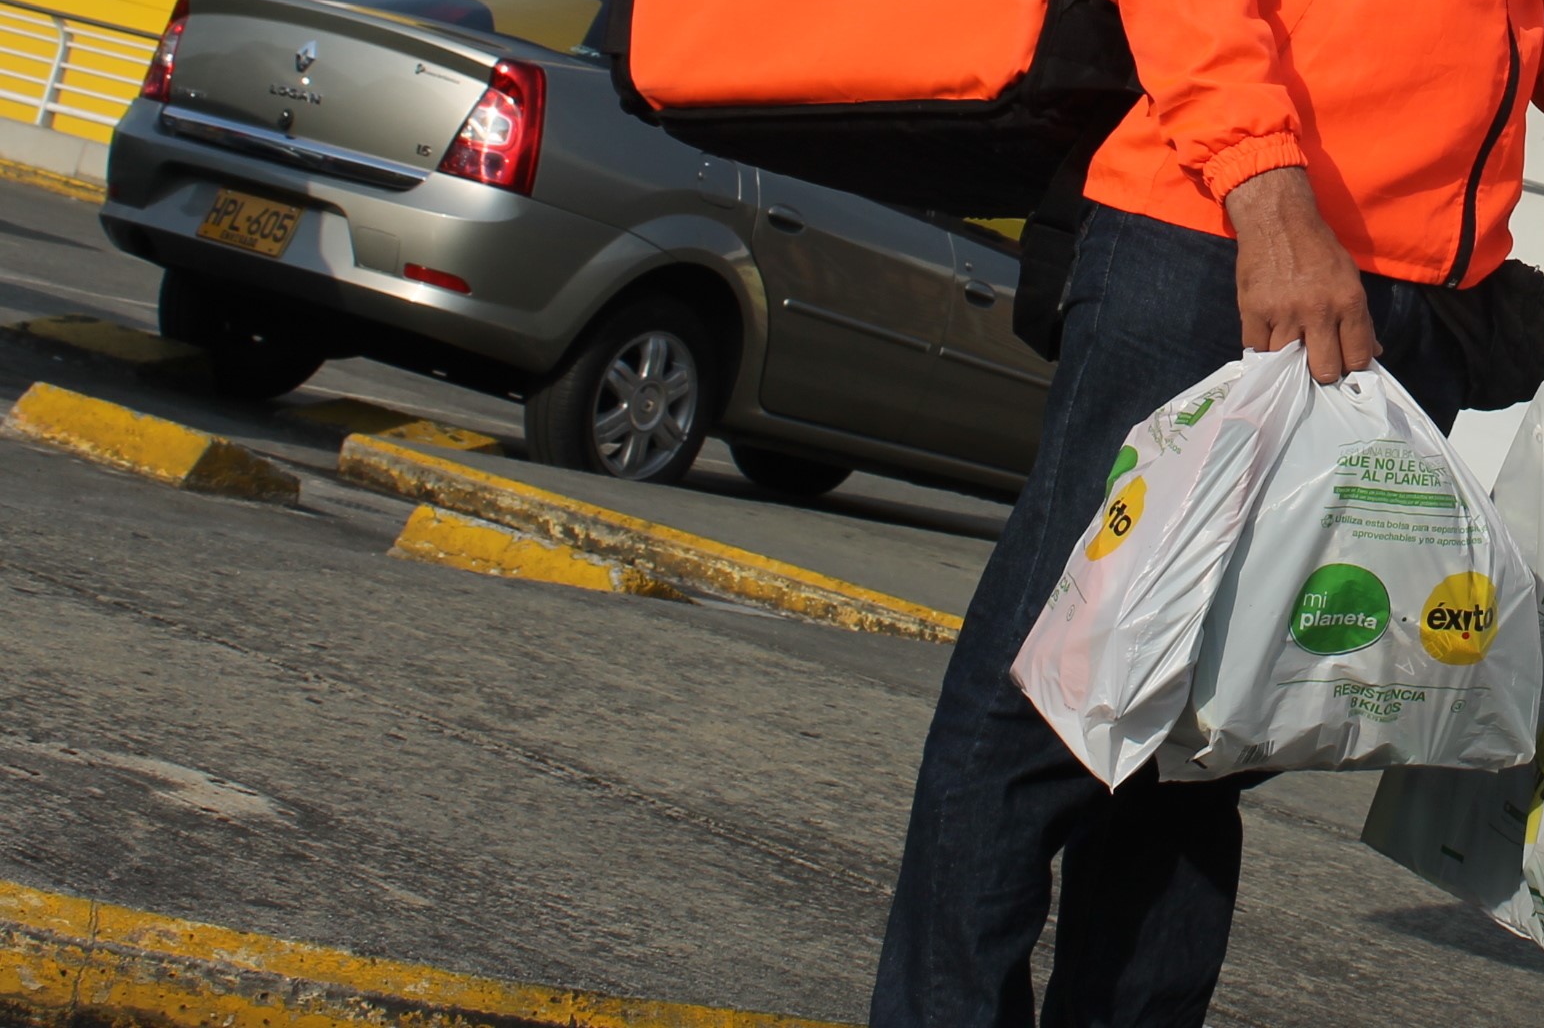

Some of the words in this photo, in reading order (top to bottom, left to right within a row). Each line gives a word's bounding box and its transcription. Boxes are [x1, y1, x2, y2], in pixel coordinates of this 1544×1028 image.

[269, 83, 322, 106] LOGAN
[1374, 457, 1395, 471] NO
[1400, 459, 1415, 472] LE
[1361, 470, 1380, 482] AL
[1384, 472, 1441, 487] PLANETA
[1335, 514, 1363, 526] Utiliza
[1365, 517, 1385, 528] esta
[1386, 518, 1409, 530] bolsa
[1411, 524, 1429, 533] para
[1352, 528, 1416, 543] aprovechables
[1303, 591, 1328, 609] mi
[1299, 609, 1378, 631] planeta
[1426, 601, 1495, 640] éxito
[1333, 683, 1426, 702] RESISTENCIA
[1359, 699, 1402, 714] KILOS
